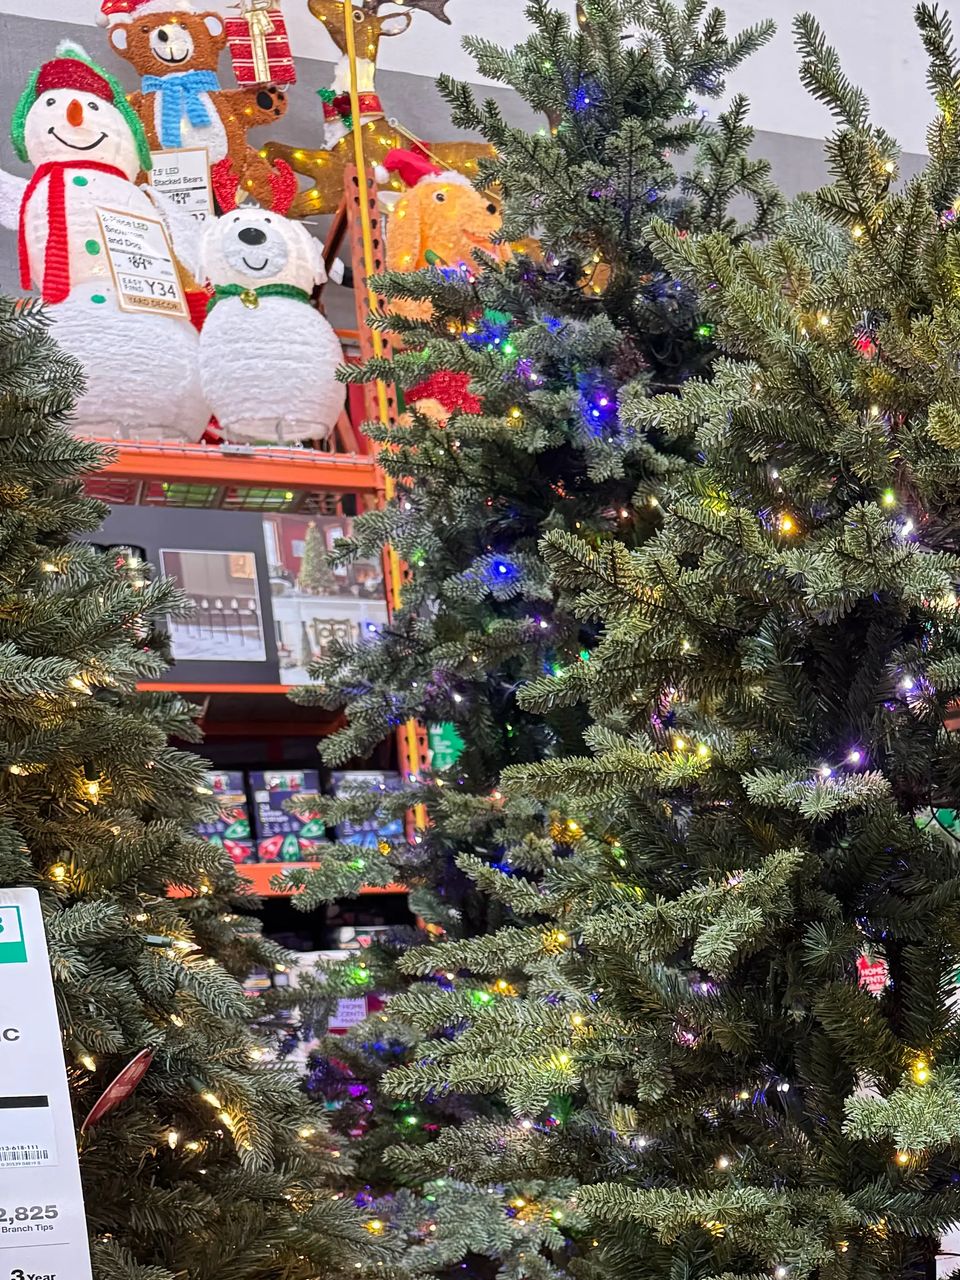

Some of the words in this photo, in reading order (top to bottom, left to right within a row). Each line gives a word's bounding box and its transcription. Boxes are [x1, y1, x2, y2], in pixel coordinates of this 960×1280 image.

[144, 279, 177, 300] Y34
[0, 1205, 59, 1225] 2,825
[1, 1225, 33, 1233] Branch
[35, 1224, 54, 1232] Tips
